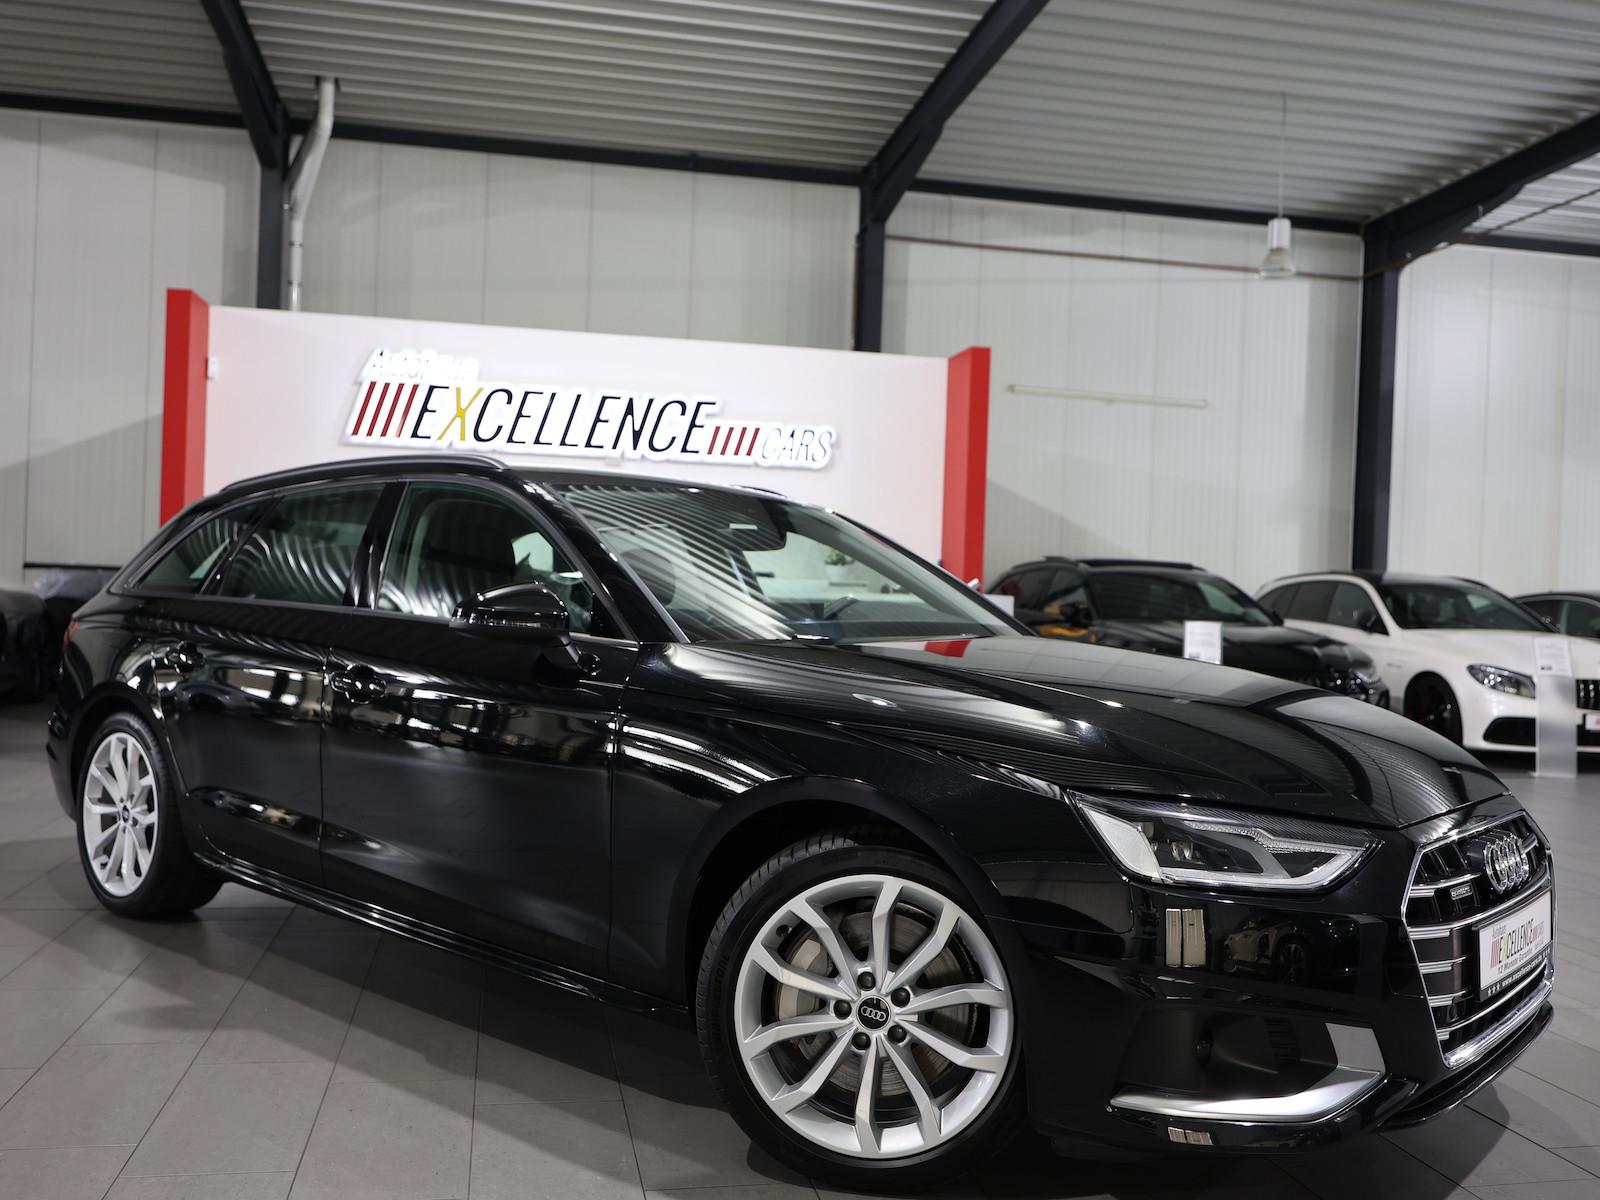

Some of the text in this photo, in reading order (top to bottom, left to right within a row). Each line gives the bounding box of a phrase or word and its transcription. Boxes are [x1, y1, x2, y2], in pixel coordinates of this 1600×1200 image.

[411, 385, 832, 462] EXCELLENCE CARS
[1498, 919, 1534, 964] EXCELLENCE
